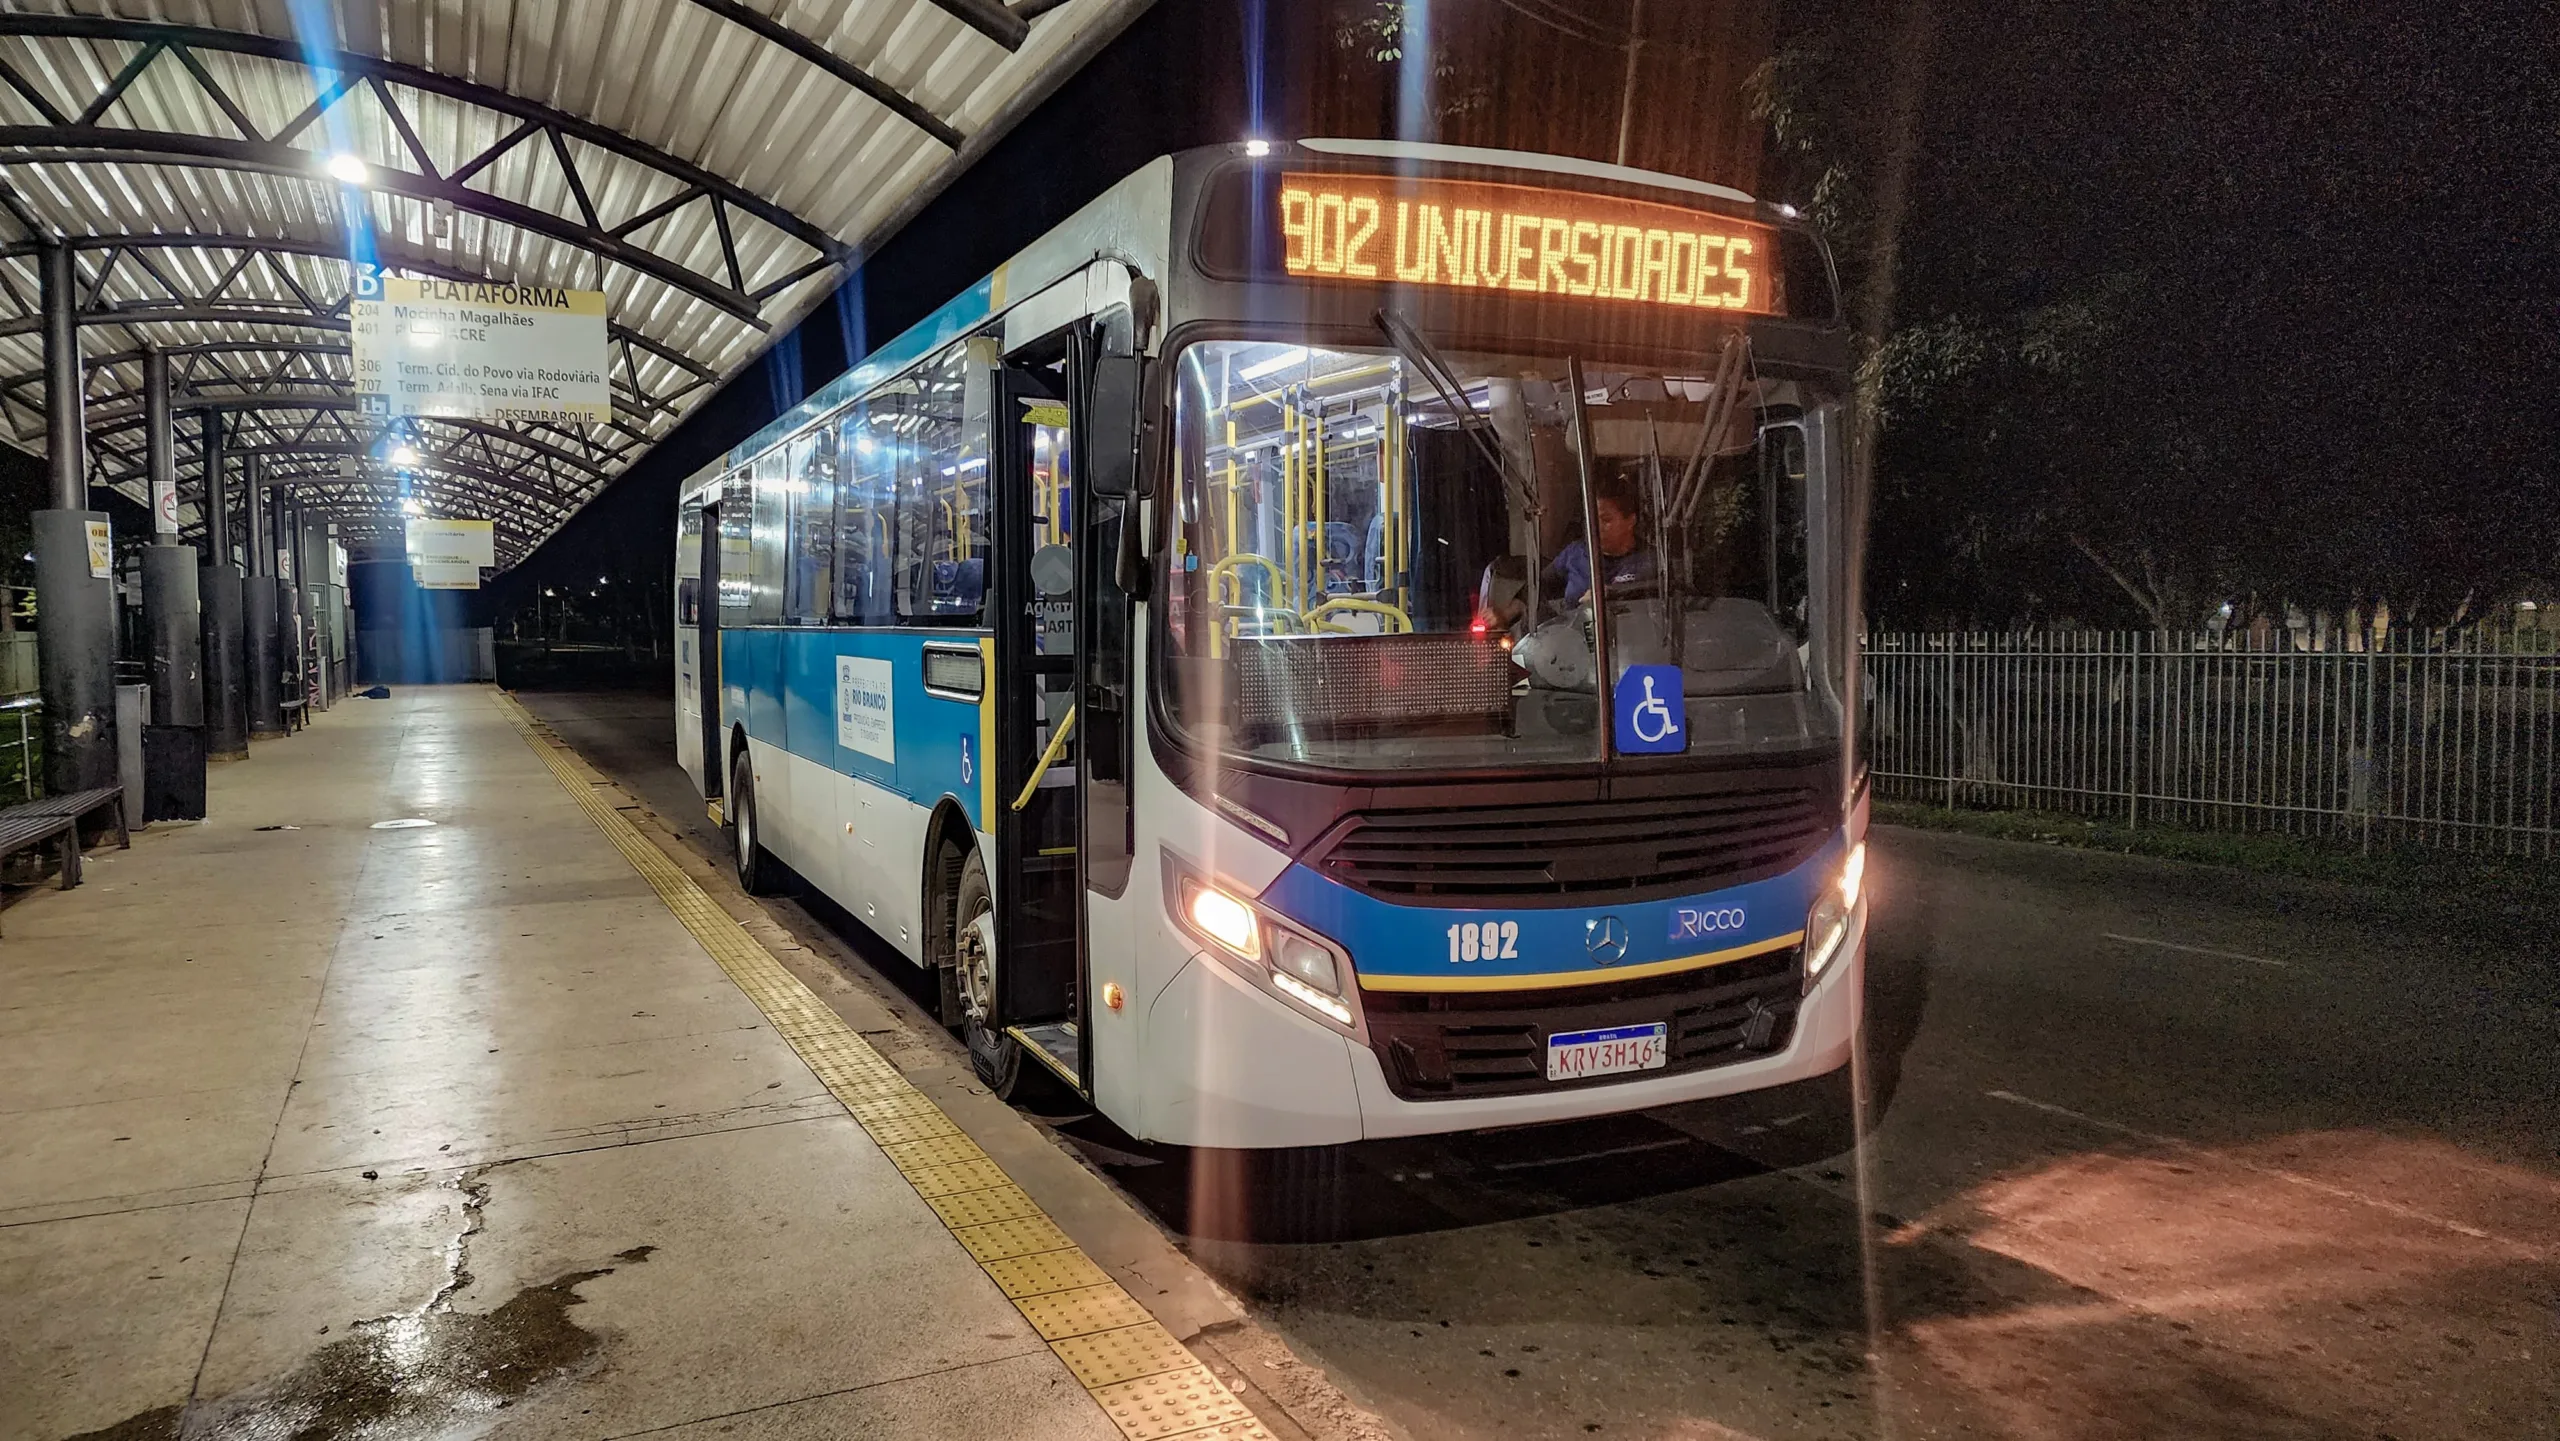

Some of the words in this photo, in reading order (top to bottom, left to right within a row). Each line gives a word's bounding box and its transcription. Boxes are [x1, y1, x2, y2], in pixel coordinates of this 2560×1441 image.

[1282, 189, 1380, 277] 902
[1396, 201, 1753, 309] UNIVERSIDADES
[420, 280, 570, 309] PLATAFORMA
[358, 304, 379, 316] 204
[395, 306, 456, 321] Mocinha
[460, 310, 534, 327] Magalhães
[358, 322, 379, 334] 401
[360, 360, 382, 372] 306
[397, 361, 433, 375] Term.
[436, 363, 460, 376] Cid.
[464, 364, 479, 377] do
[484, 366, 513, 379] Povo
[517, 367, 534, 380] via
[538, 369, 600, 383] Rodoviária
[361, 379, 382, 392] 707
[398, 380, 433, 394] Term.
[480, 384, 508, 397] Sena
[511, 385, 528, 398] via
[532, 386, 559, 399] IFAC
[852, 689, 861, 706] RIO
[863, 692, 886, 711] BRANCO
[1670, 908, 1745, 939] RICCO
[1447, 921, 1519, 963] 1892
[1560, 1040, 1653, 1073] KRY3H16
